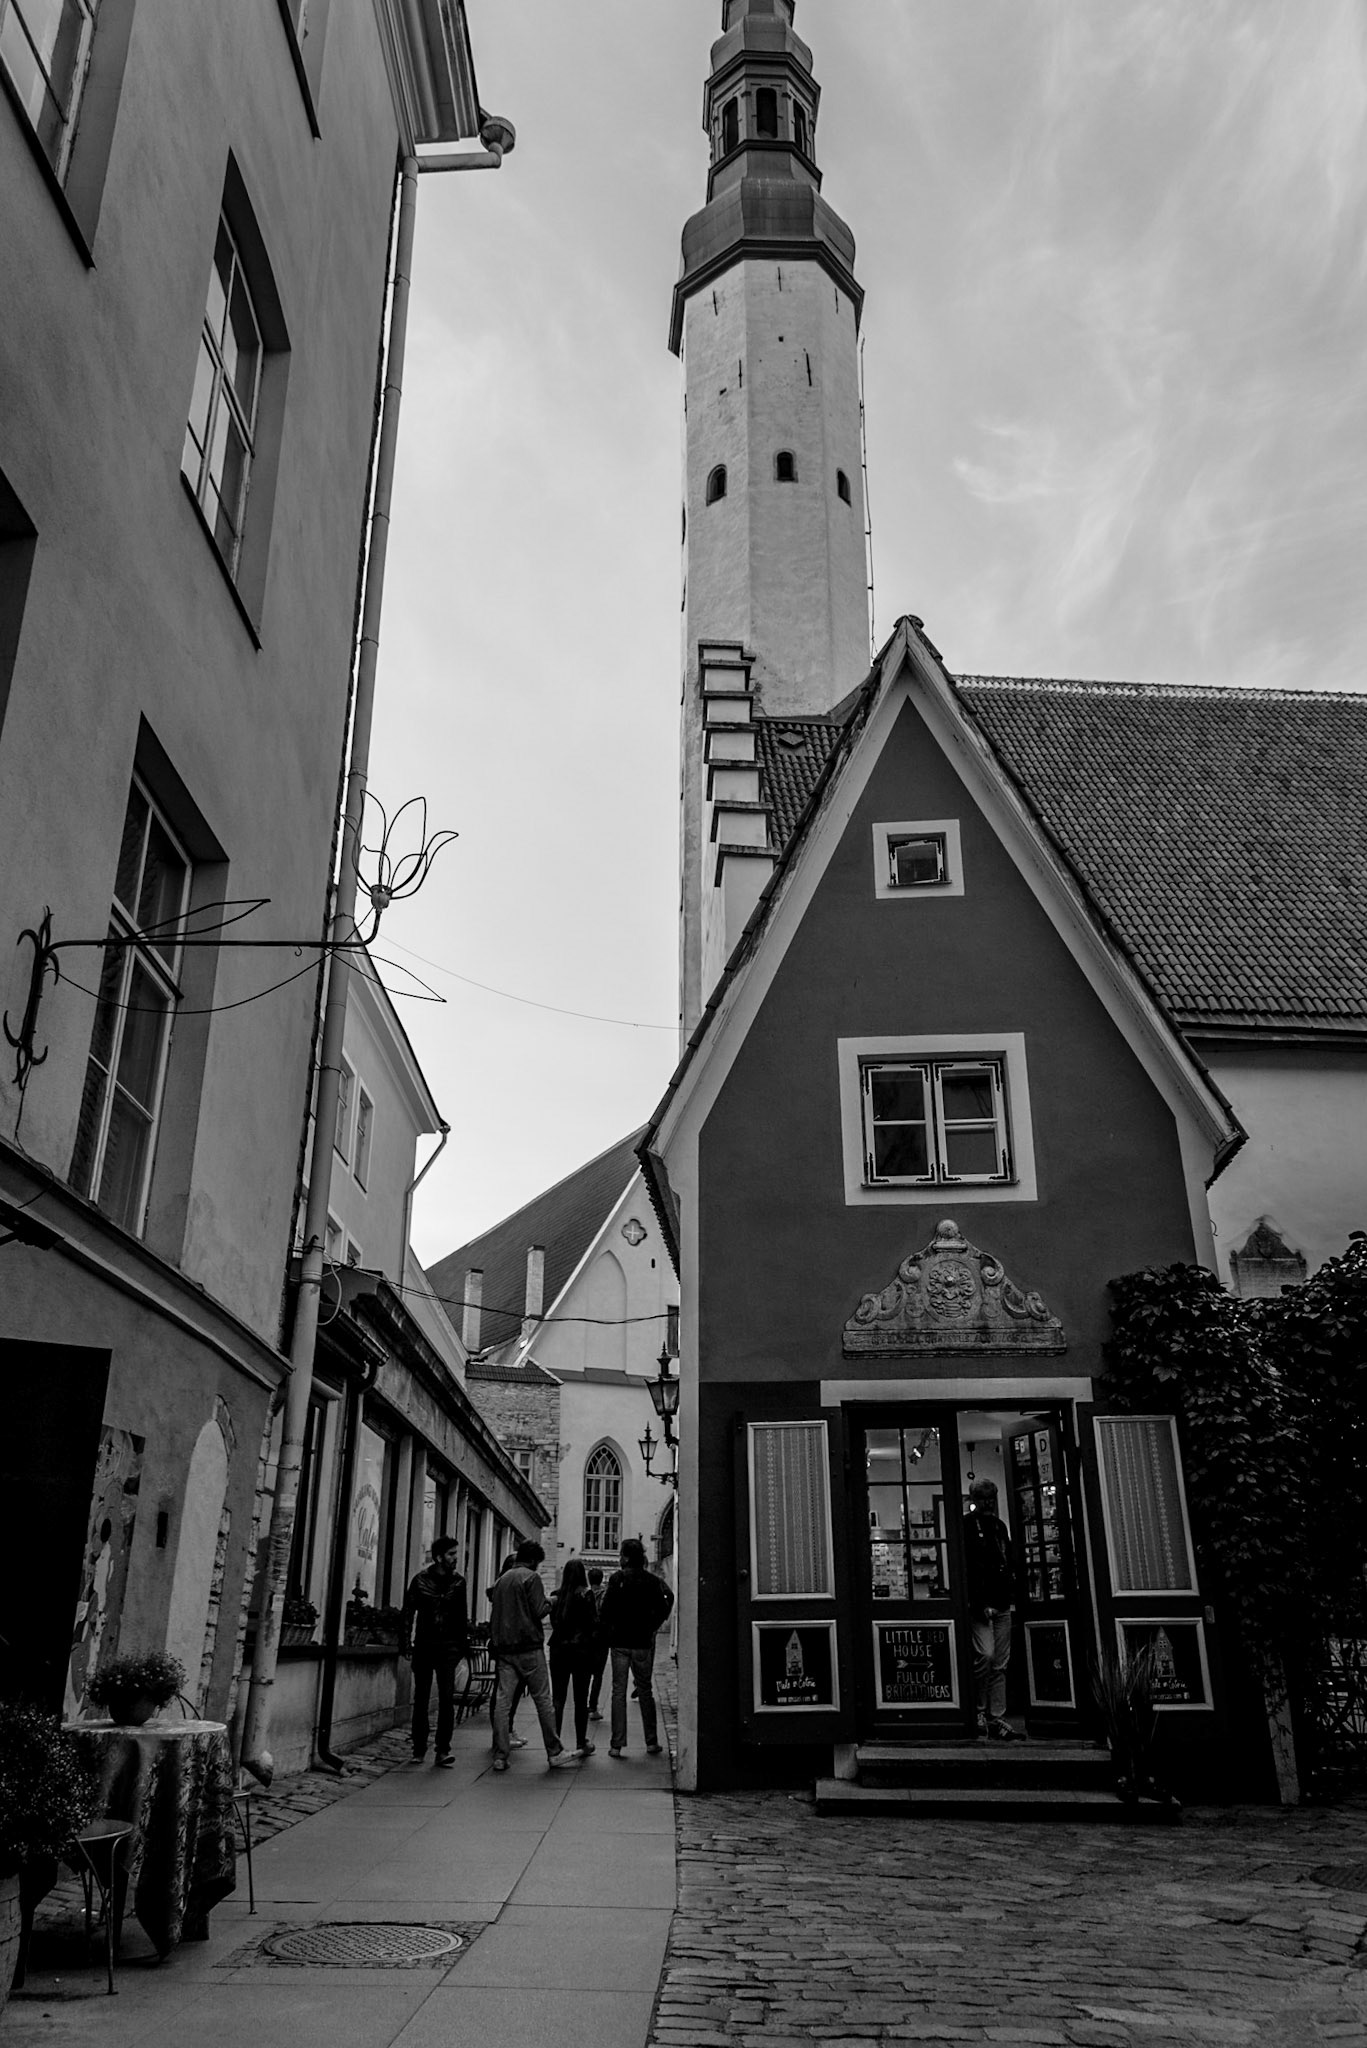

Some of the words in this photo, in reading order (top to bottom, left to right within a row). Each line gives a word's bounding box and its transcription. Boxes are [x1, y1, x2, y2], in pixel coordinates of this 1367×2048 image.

[885, 1629, 924, 1644] LITTLE
[927, 1630, 945, 1644] RED
[893, 1644, 933, 1658] HOUSE
[896, 1671, 922, 1684] FULL
[922, 1670, 936, 1684] OF
[885, 1684, 927, 1700] BRIGHT
[927, 1684, 951, 1699] IDEAS
